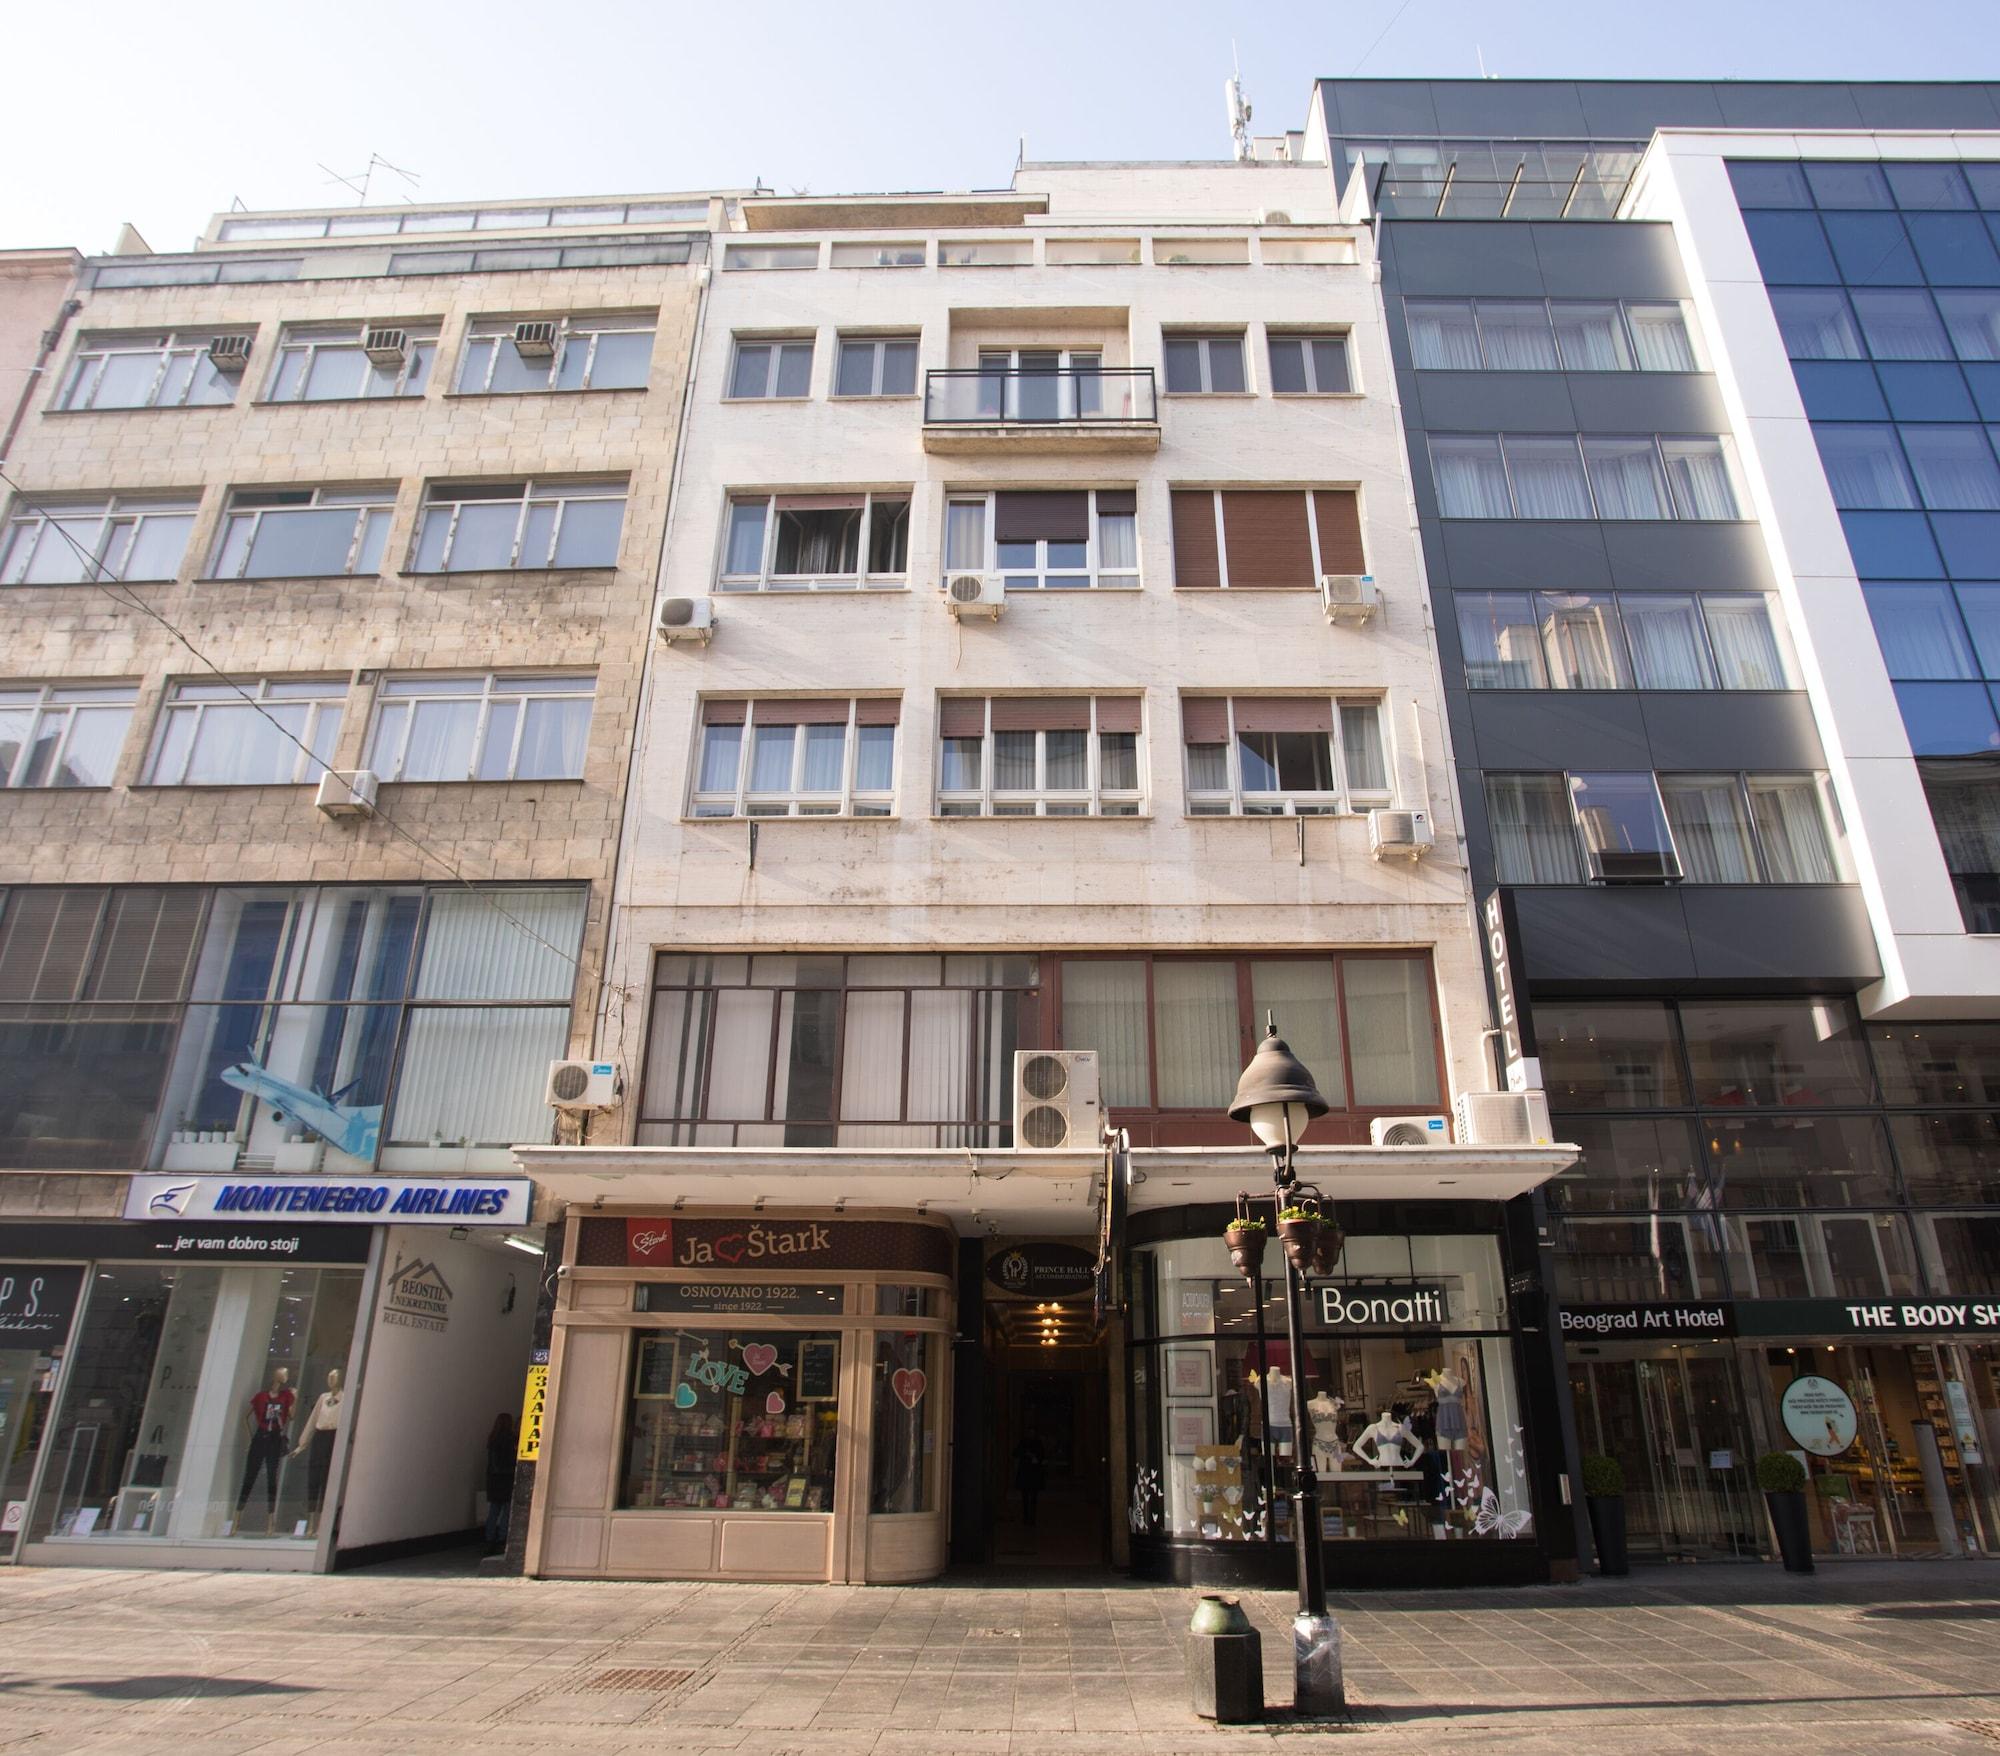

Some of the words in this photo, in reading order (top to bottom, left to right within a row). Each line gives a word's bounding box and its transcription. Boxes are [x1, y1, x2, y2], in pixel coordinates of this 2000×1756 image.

[1486, 897, 1518, 1059] HOTEL
[213, 1185, 387, 1213] MONTENEGRO
[389, 1187, 510, 1215] AIRLINES
[197, 1238, 225, 1249] vam
[227, 1236, 268, 1250] dobro
[270, 1237, 299, 1253] stoji
[680, 1237, 714, 1265] Ja
[747, 1223, 831, 1258] Štark
[1034, 1266, 1064, 1274] PRINCE
[1066, 1266, 1089, 1274] HALL
[401, 1279, 445, 1301] BEOSTIL
[680, 1285, 763, 1298] OSNOVANO
[766, 1287, 800, 1299] 1922.
[394, 1295, 448, 1314] NEKRETNINE
[713, 1302, 738, 1313] since
[1321, 1287, 1442, 1324] Bonatti
[1845, 1305, 1897, 1327] THE
[1901, 1304, 1967, 1327] BODY
[383, 1311, 410, 1327] REAL
[410, 1315, 447, 1333] ESTATE
[1559, 1310, 1638, 1333] Beograd
[1643, 1310, 1671, 1328] Art
[1675, 1308, 1725, 1327] Hotel
[535, 1351, 548, 1361] 23
[685, 1352, 750, 1396] LOVE
[526, 1375, 548, 1453] ЗЛАТАР
